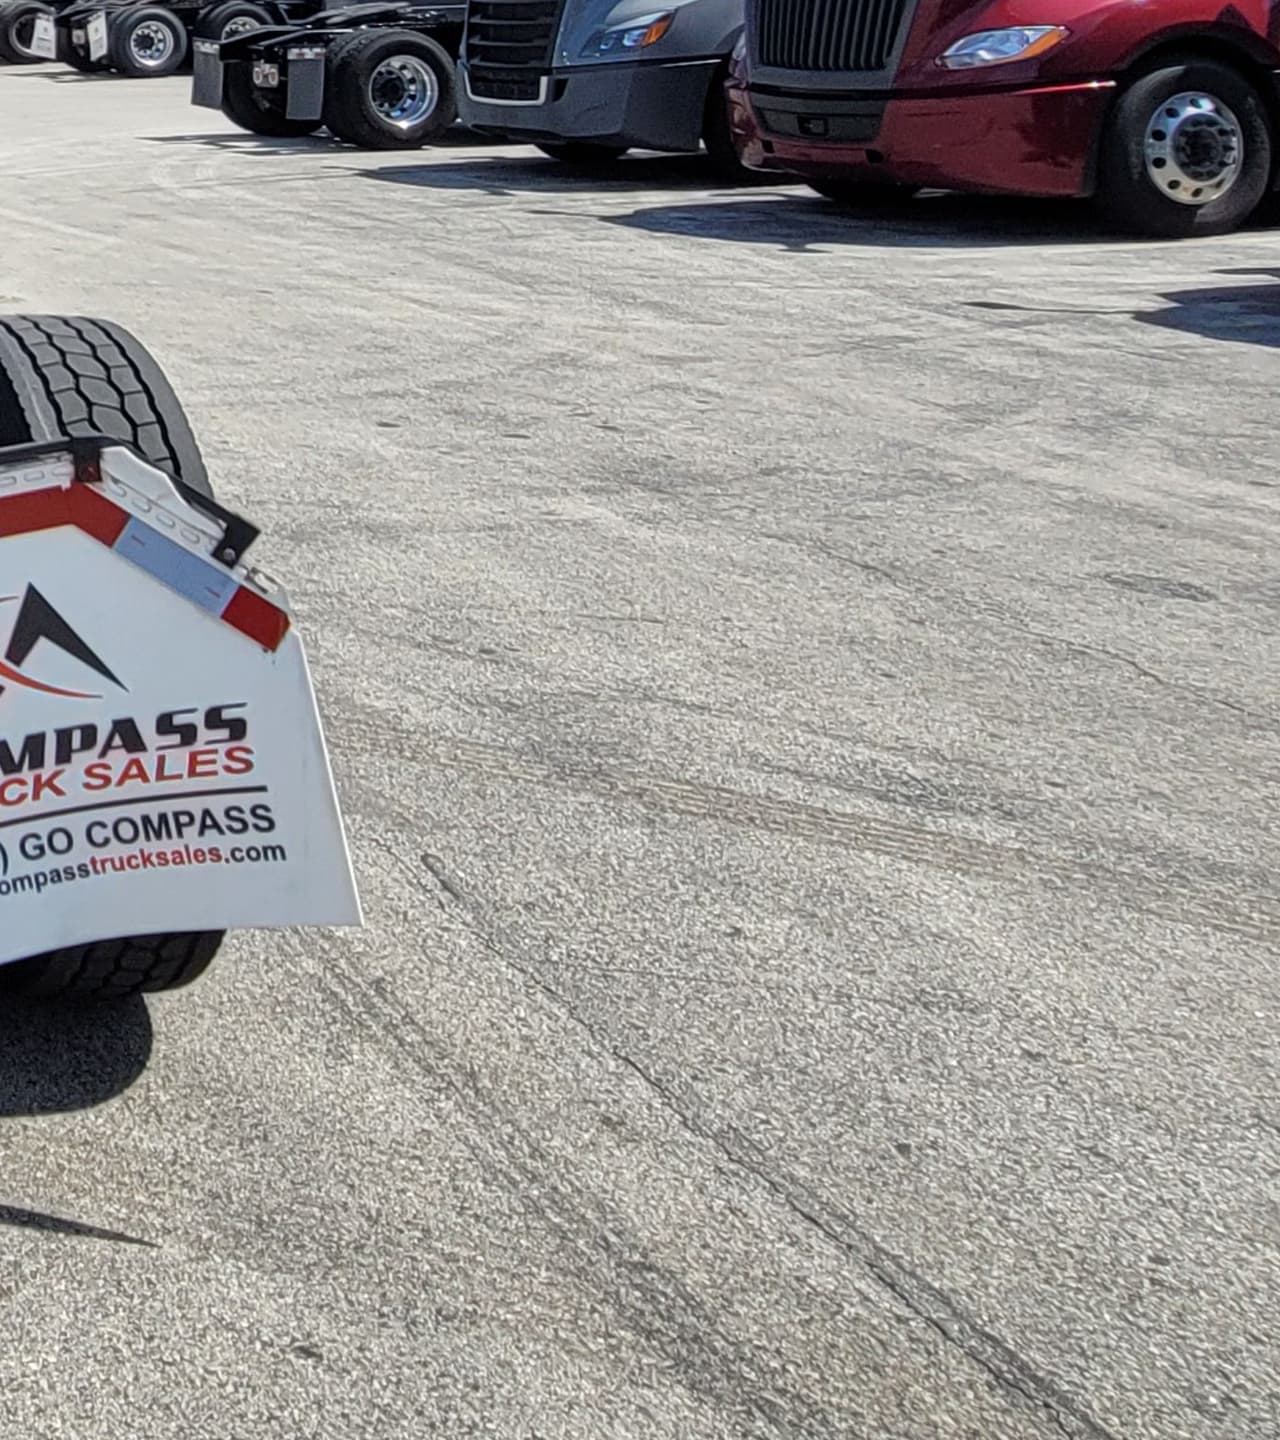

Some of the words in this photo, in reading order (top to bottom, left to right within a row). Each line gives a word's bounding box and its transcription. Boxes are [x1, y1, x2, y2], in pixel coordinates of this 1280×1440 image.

[81, 746, 255, 792] SALES
[19, 827, 74, 861] GO
[85, 803, 276, 849] COMPASS
